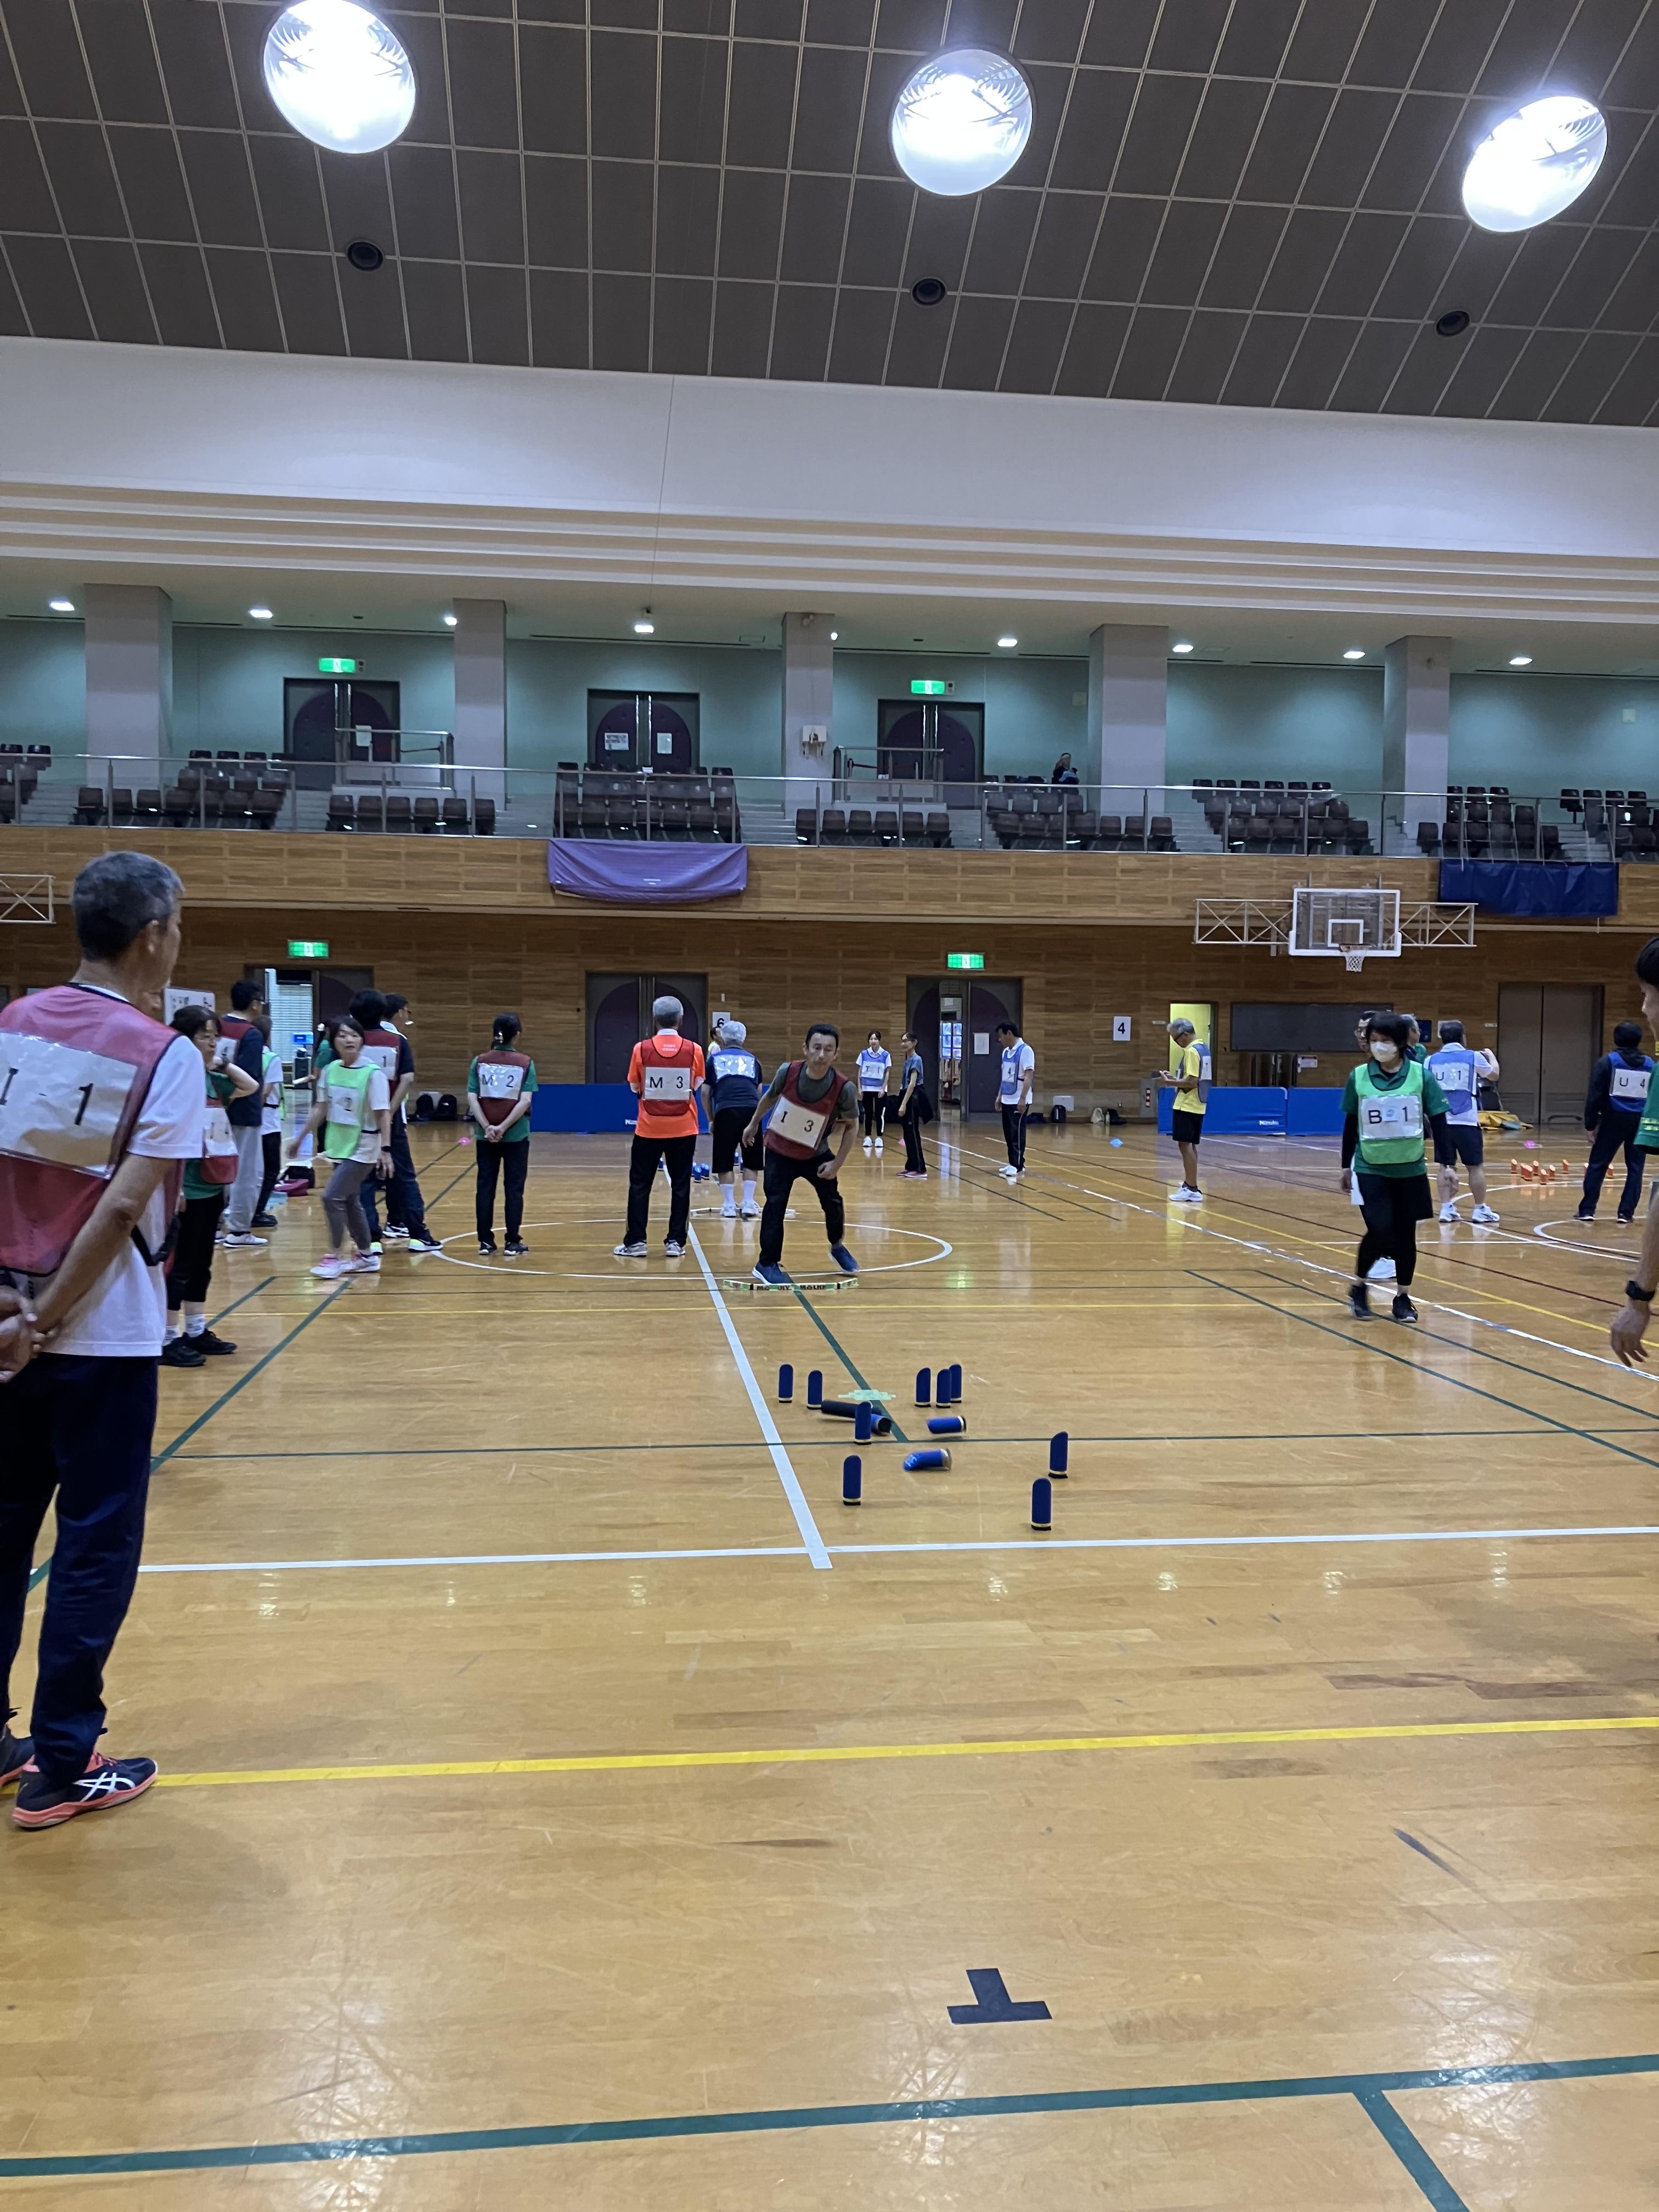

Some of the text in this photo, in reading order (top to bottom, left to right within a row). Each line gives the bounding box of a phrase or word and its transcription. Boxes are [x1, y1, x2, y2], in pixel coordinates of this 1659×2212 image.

[717, 1018, 725, 1028] 6
[1118, 1023, 1125, 1034] 4
[382, 1055, 387, 1068] 1
[482, 1074, 514, 1088] M 2
[1436, 1070, 1461, 1081] U 1
[650, 1076, 683, 1089] M 3
[1620, 1077, 1645, 1088] U 4
[0, 1067, 19, 1106] I
[74, 1083, 93, 1126] 1
[1368, 1109, 1382, 1124] B
[1402, 1105, 1408, 1122] 1
[781, 1111, 814, 1132] I 3
